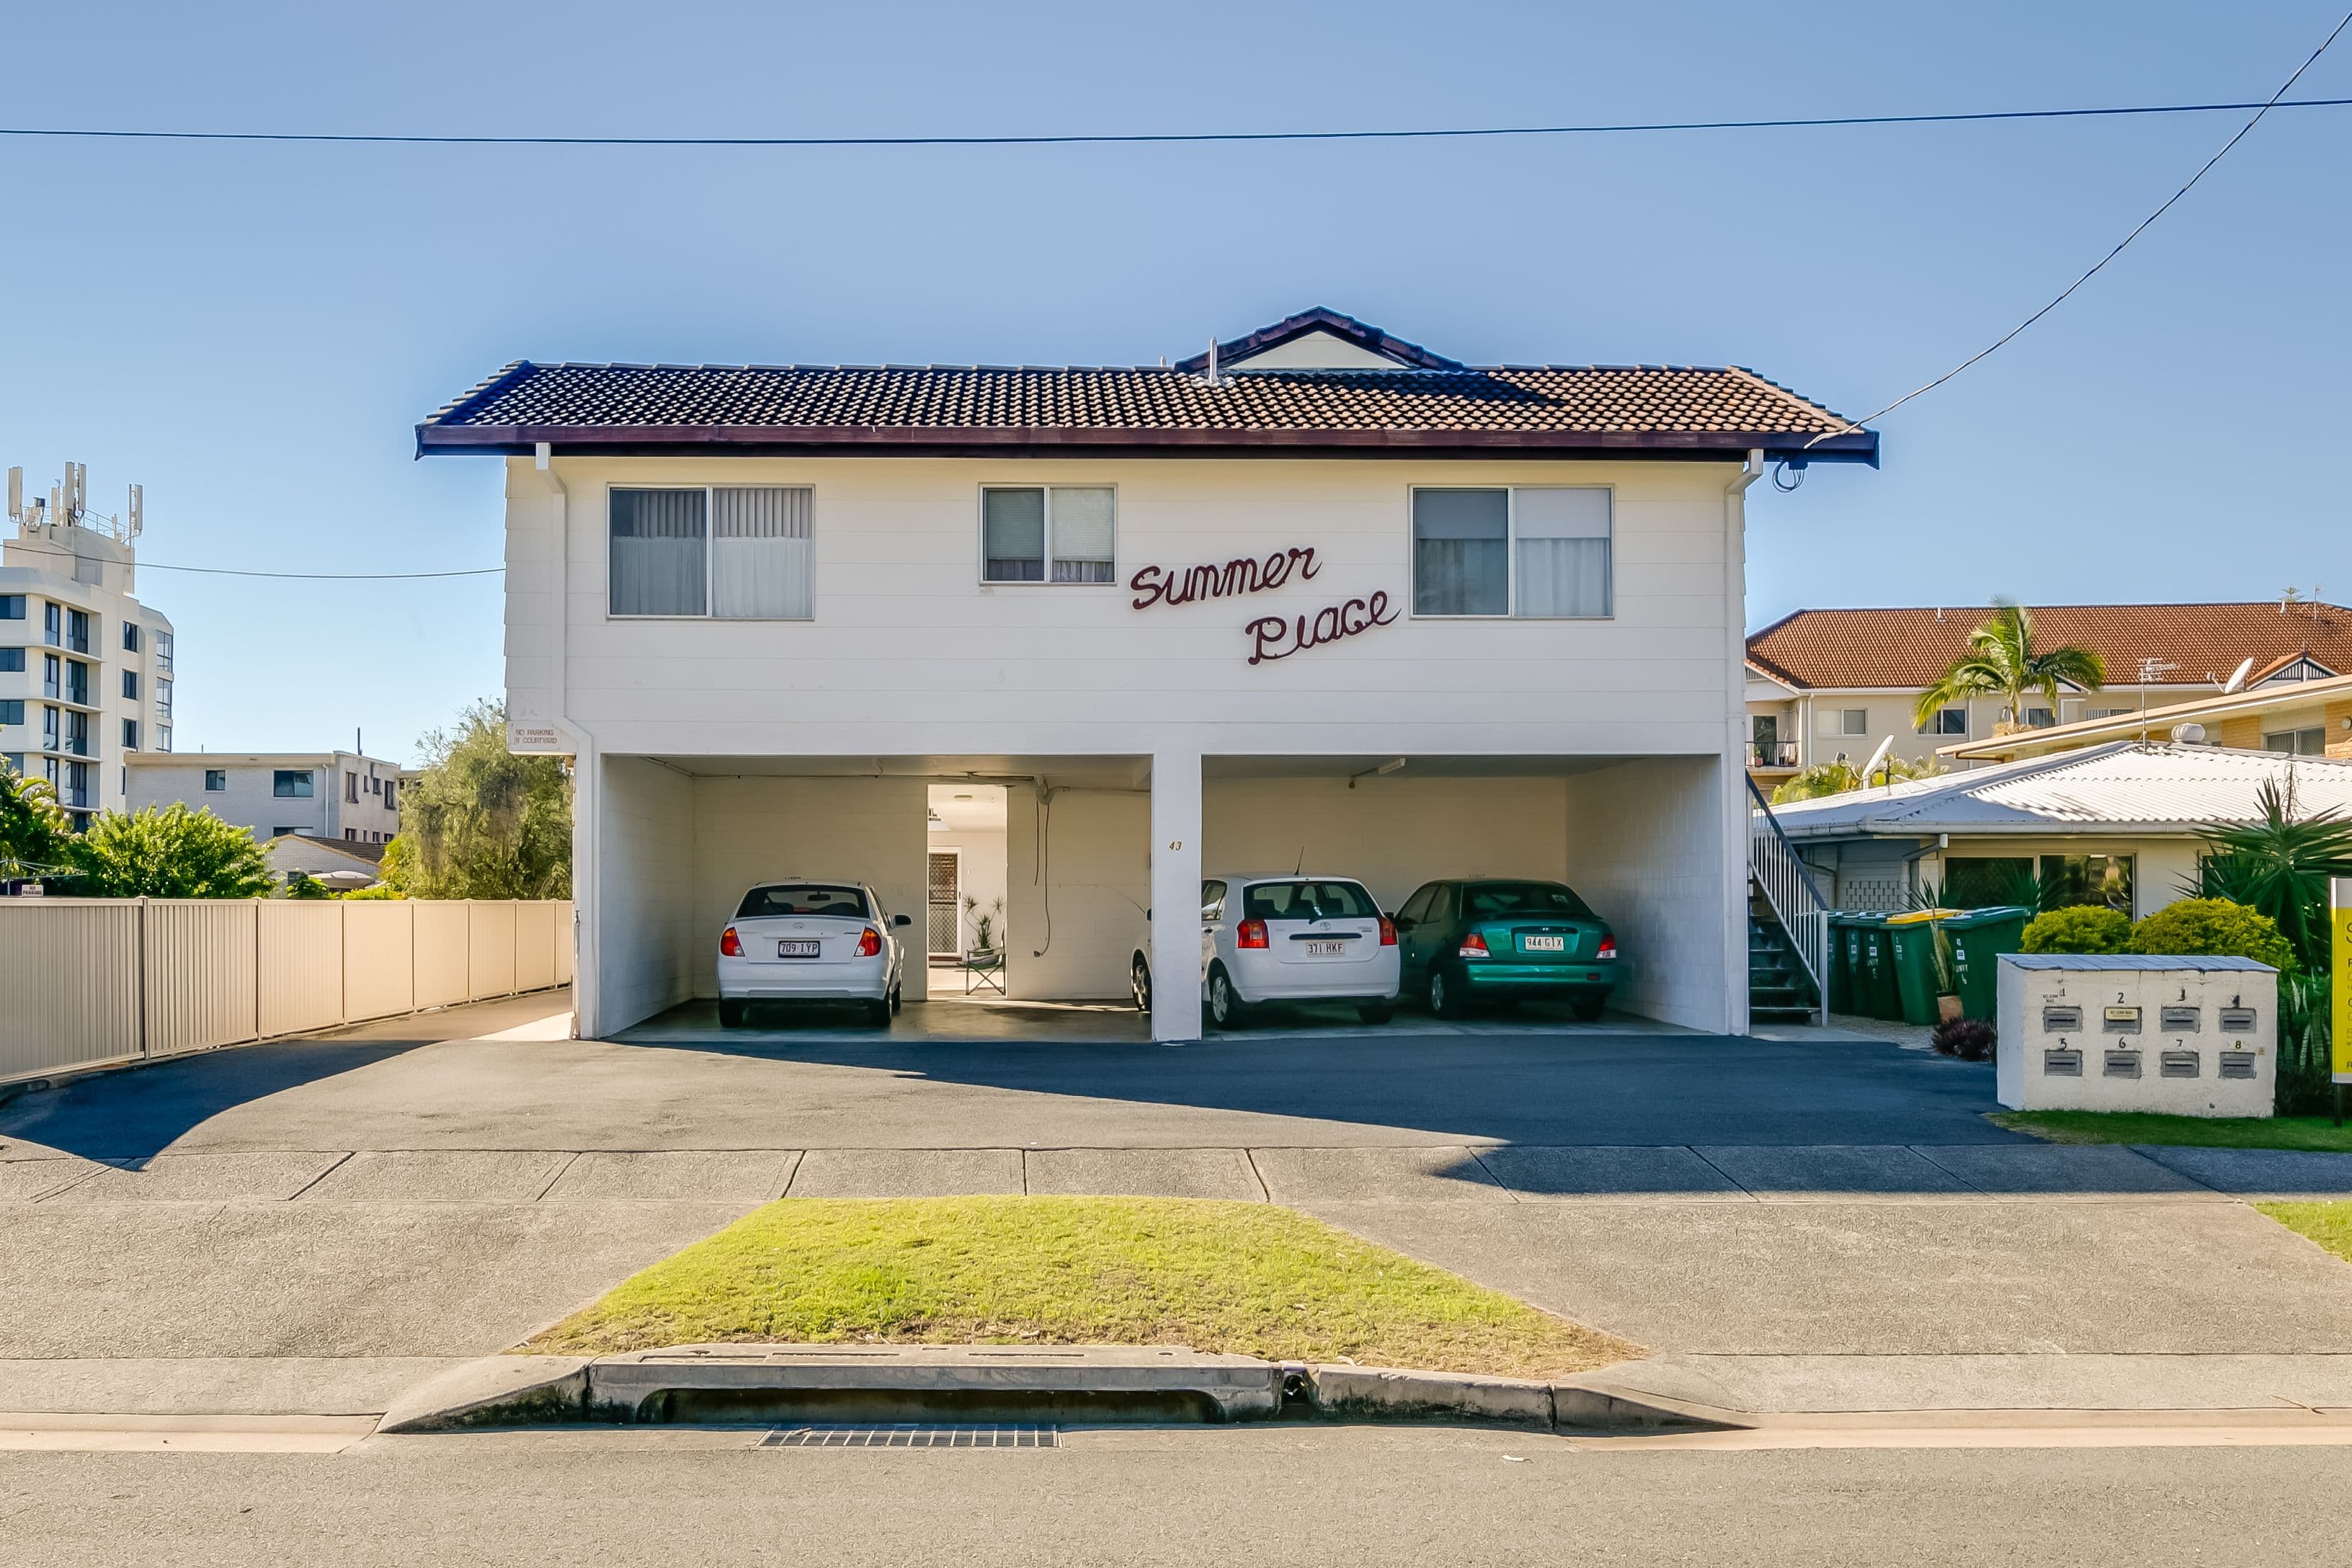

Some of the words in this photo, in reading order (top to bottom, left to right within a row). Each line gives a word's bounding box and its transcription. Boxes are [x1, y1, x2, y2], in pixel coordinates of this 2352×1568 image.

[1131, 546, 1323, 610] Summer
[1245, 589, 1402, 665] Place
[1168, 841, 1182, 851] 43
[1526, 937, 1541, 946] 944
[780, 943, 796, 953] 709
[801, 943, 818, 953] IYP
[1308, 943, 1322, 953] 371
[1326, 943, 1343, 953] HKF
[2059, 987, 2066, 997] 1
[2117, 992, 2124, 1004] 2
[2119, 1036, 2126, 1049] 6
[2235, 1041, 2242, 1049] 8
